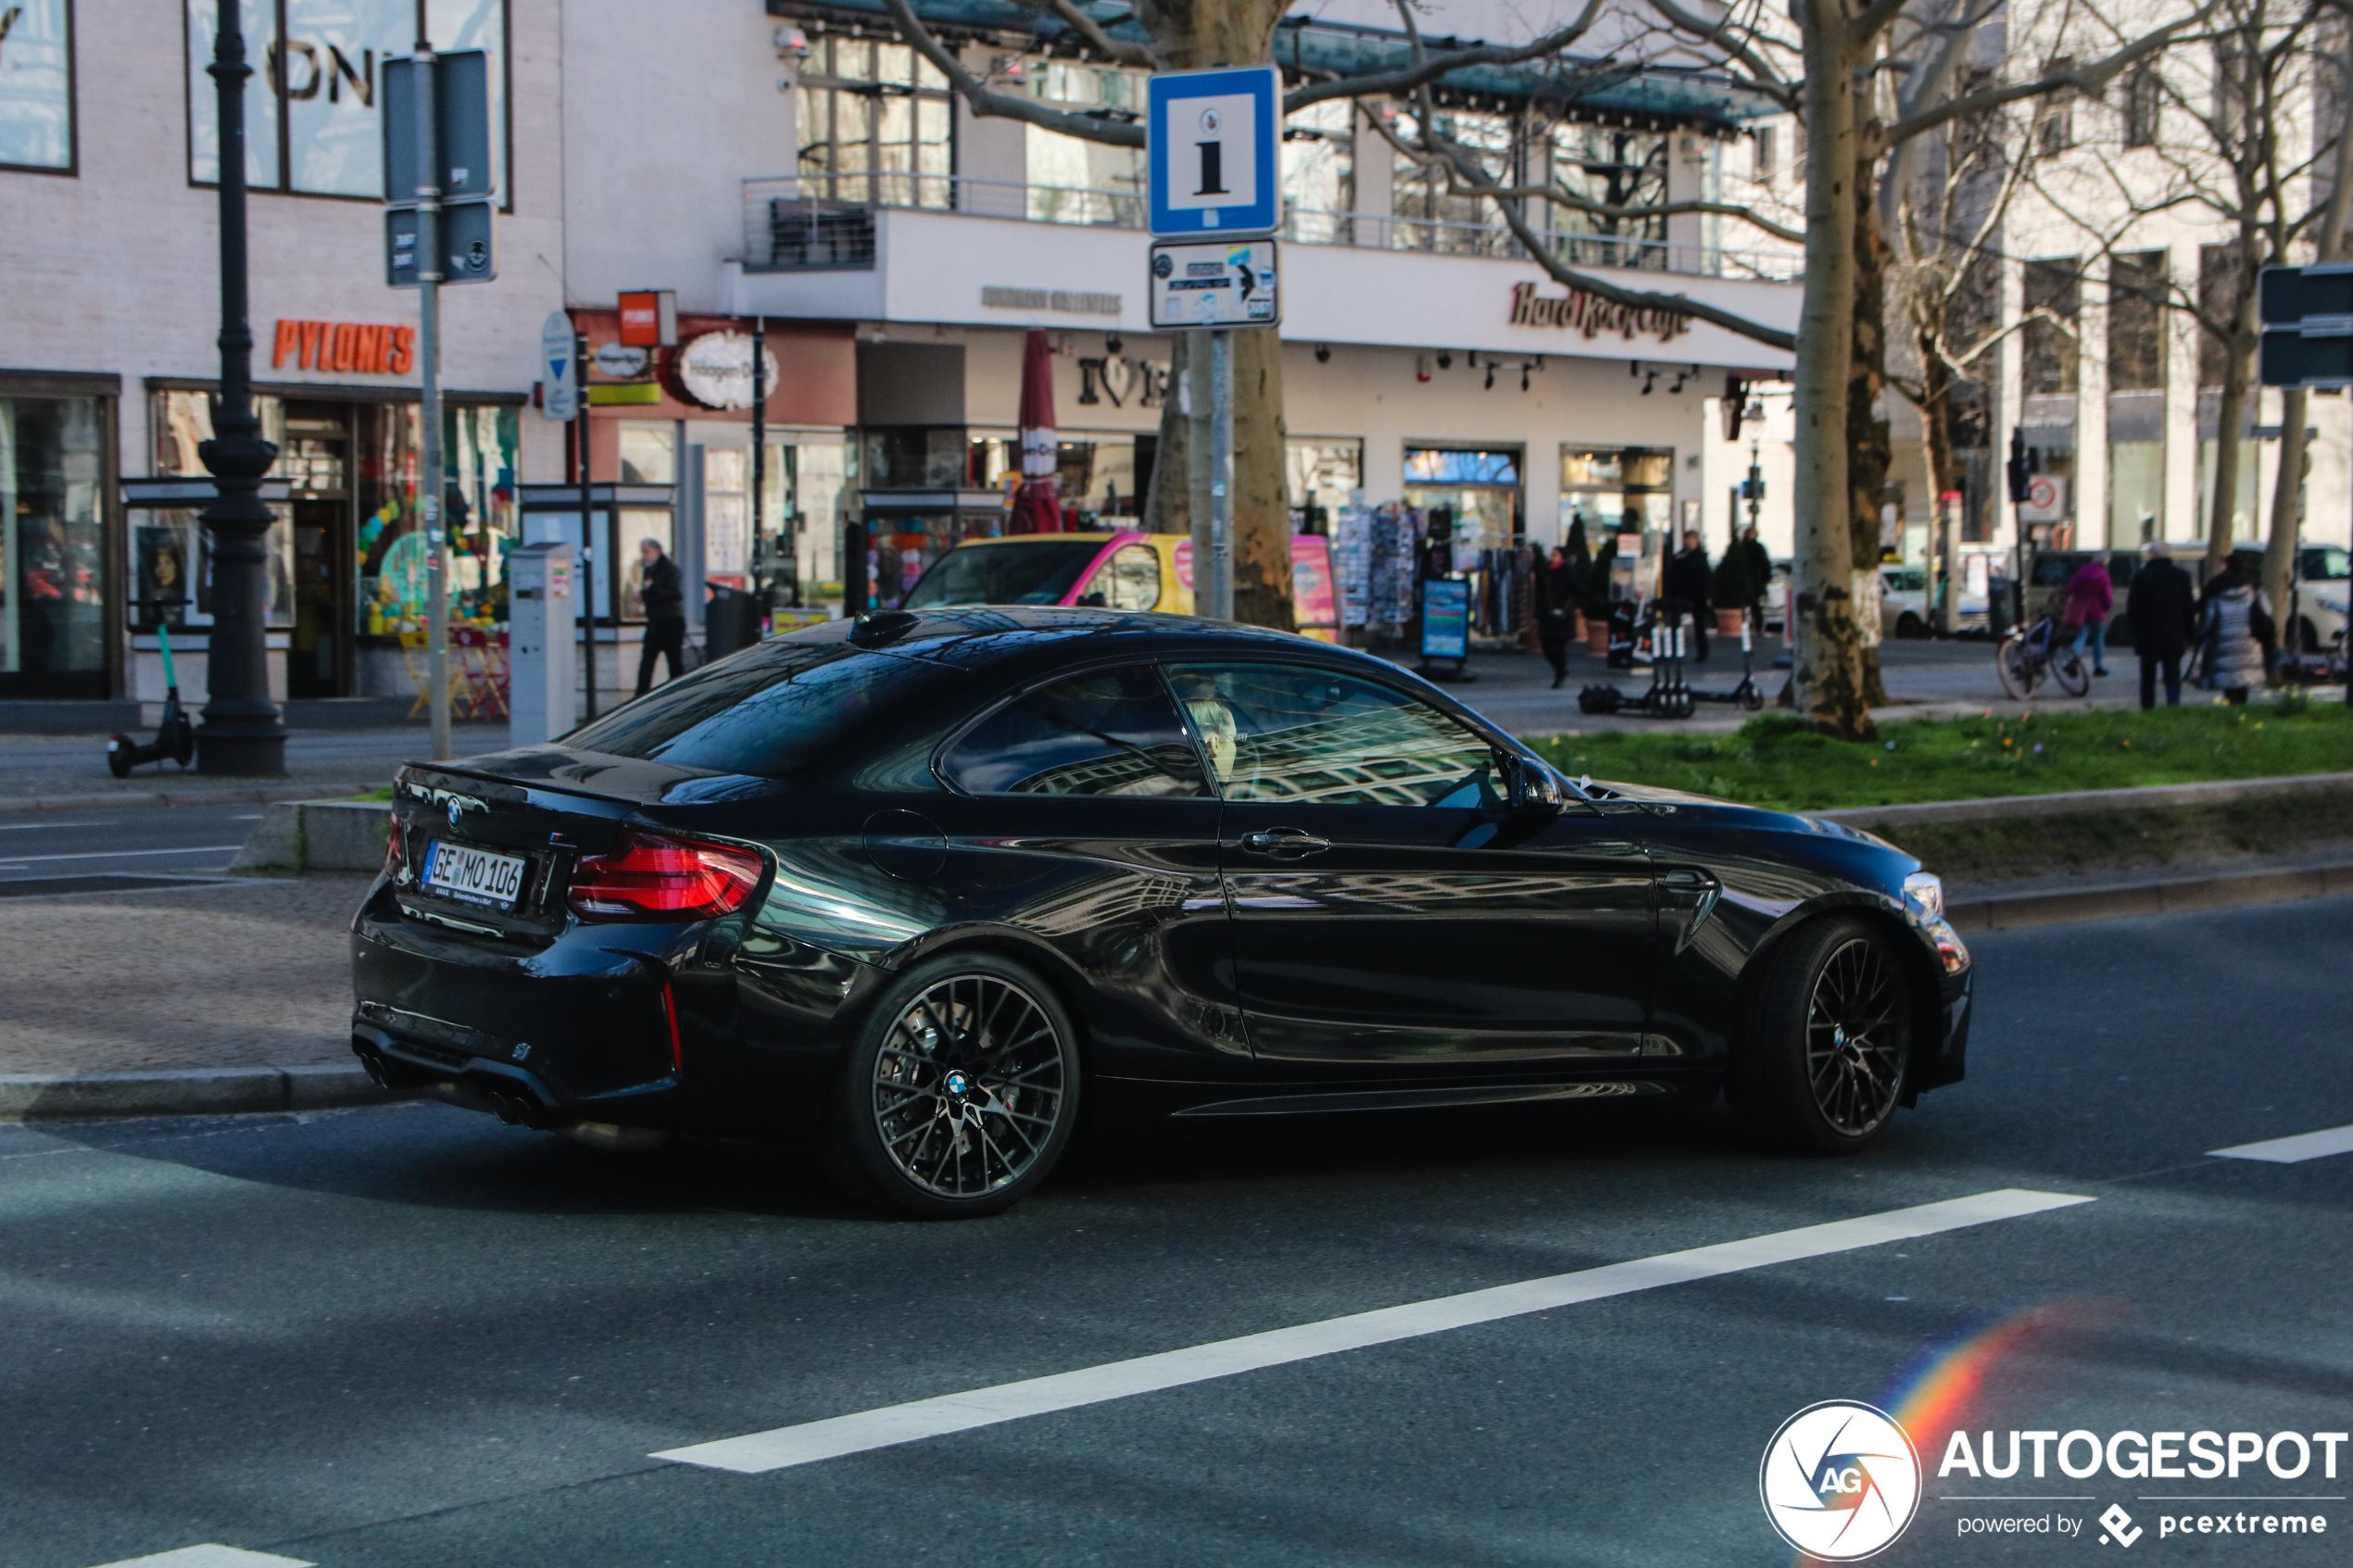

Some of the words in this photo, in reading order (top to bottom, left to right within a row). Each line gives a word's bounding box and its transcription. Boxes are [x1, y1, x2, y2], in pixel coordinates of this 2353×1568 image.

[1510, 281, 1580, 327] Hard
[1578, 291, 1640, 340] Rock
[273, 319, 415, 374] PYLONES
[433, 847, 456, 882] GE
[460, 853, 485, 889] MO
[484, 859, 519, 896] 106
